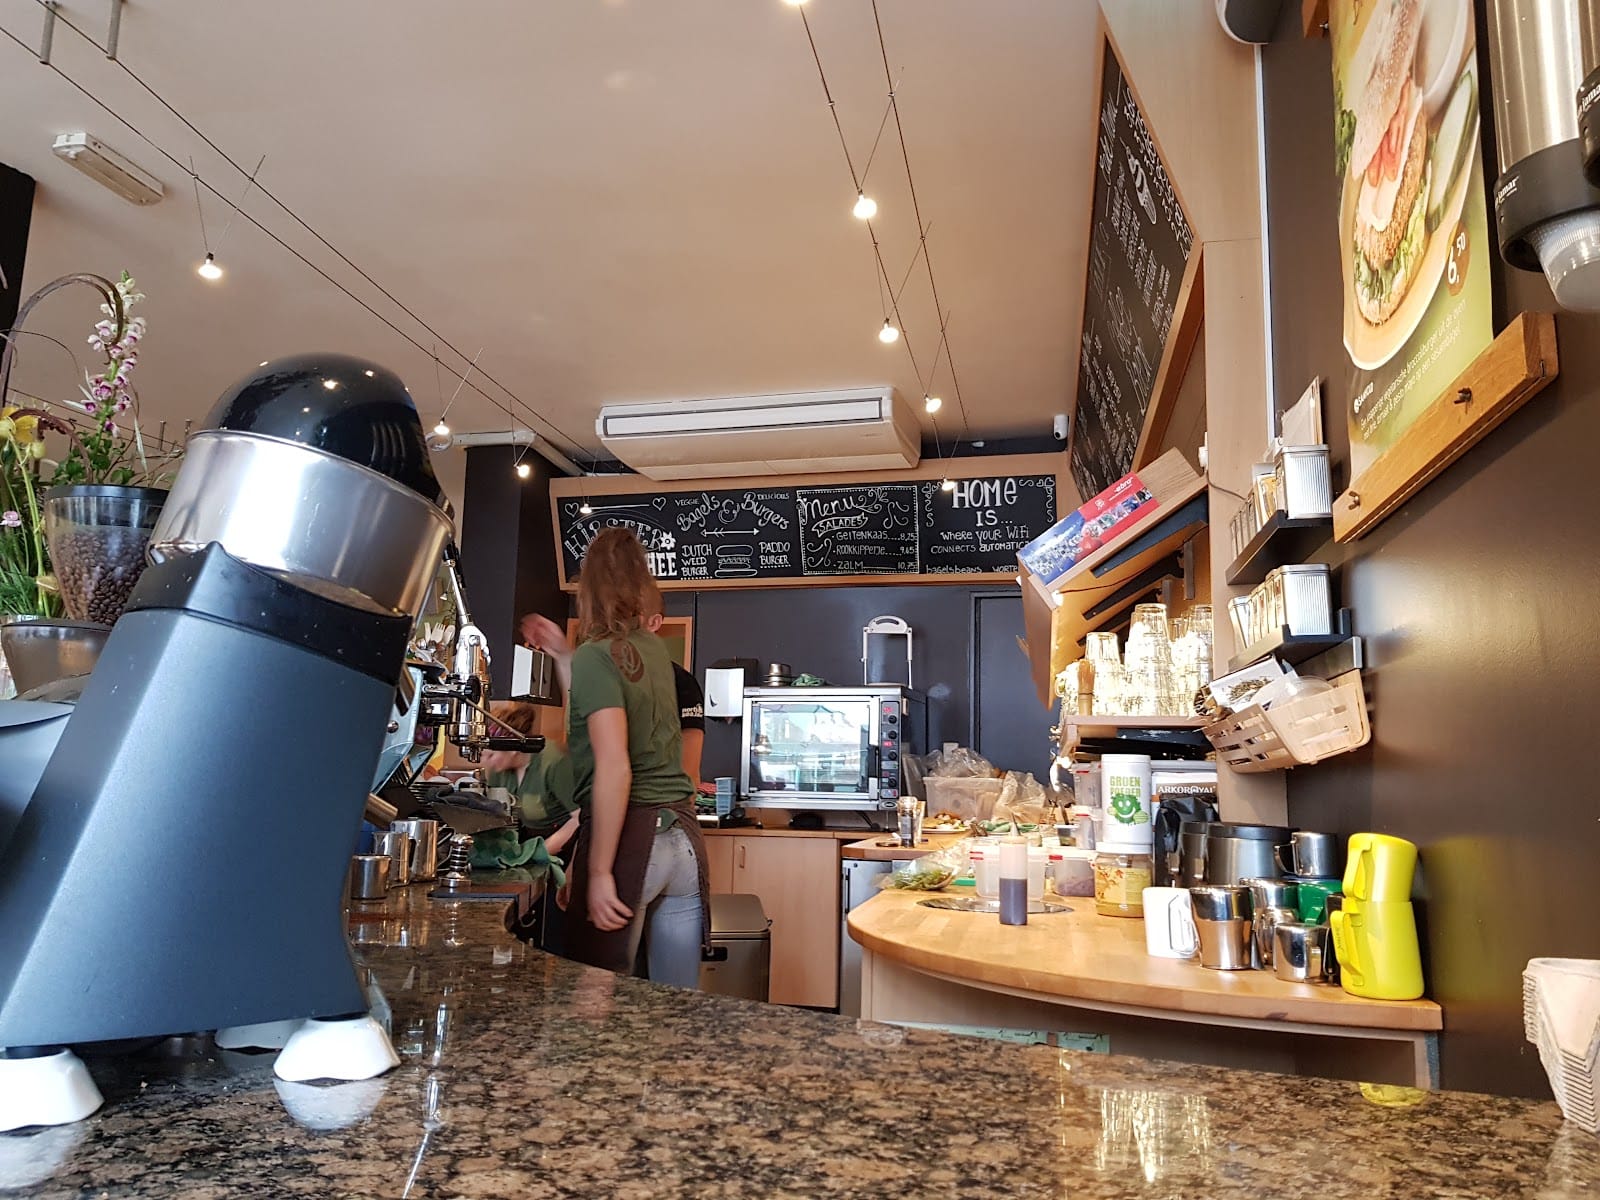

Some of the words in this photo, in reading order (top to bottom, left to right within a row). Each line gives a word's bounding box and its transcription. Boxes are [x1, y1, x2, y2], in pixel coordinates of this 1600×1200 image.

[796, 495, 857, 526] Menu
[819, 516, 863, 533] SALADES
[681, 544, 713, 557] DUTCH
[758, 541, 791, 554] PADDO
[681, 556, 708, 567] WEED
[759, 554, 790, 566] BURGER
[680, 566, 709, 577] BURGER
